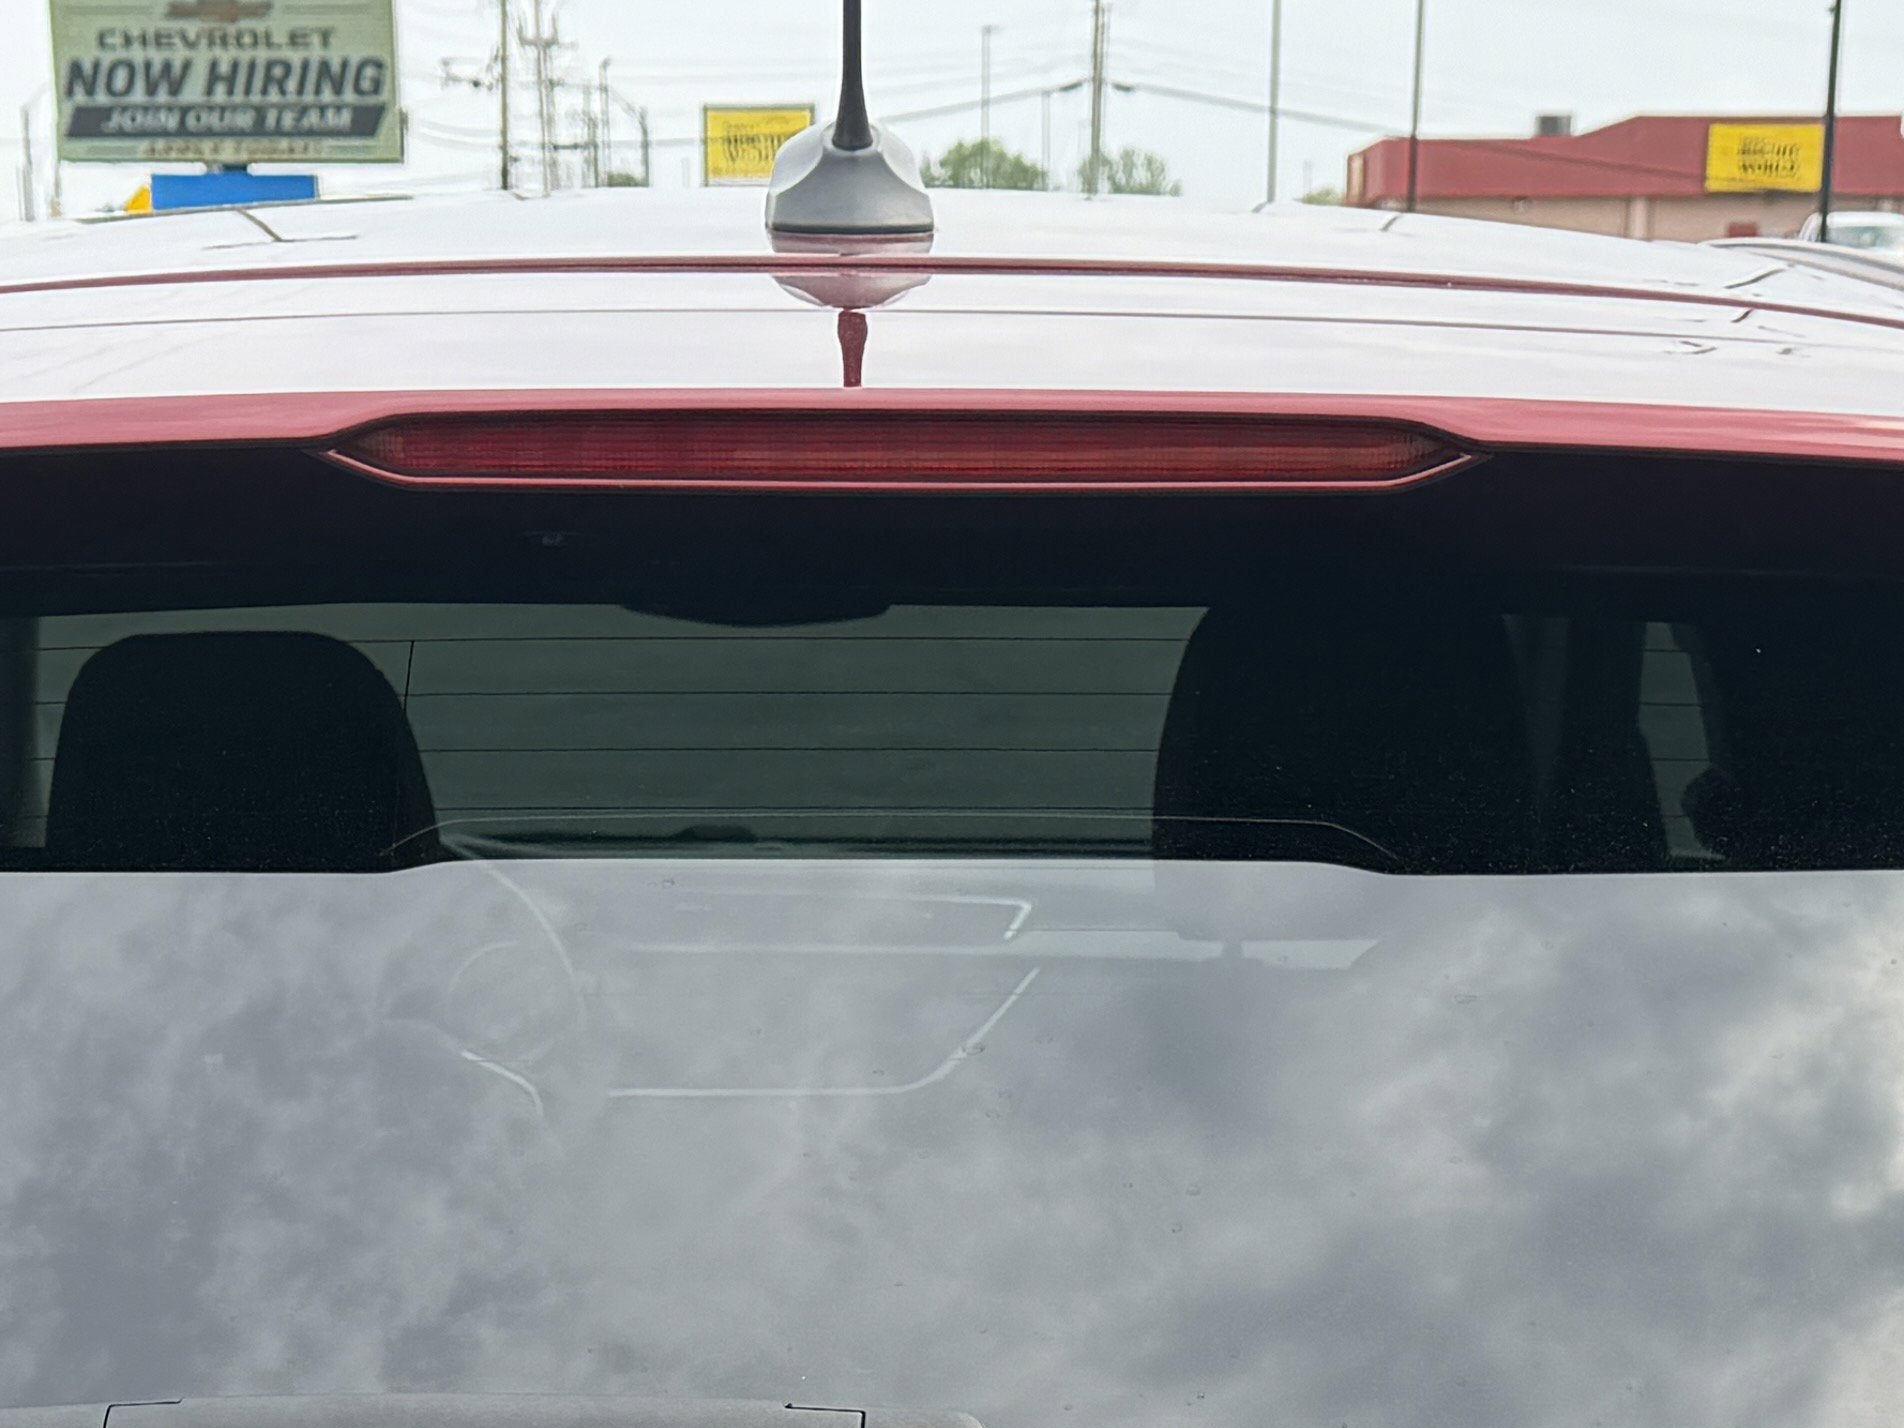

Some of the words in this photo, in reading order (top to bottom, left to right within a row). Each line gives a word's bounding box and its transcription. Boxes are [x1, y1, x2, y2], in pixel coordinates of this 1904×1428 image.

[97, 26, 335, 50] CHEVROLET
[62, 57, 193, 98] NOW
[205, 57, 385, 98] HIRING
[101, 107, 178, 134] JOIN
[184, 108, 256, 134] OUR
[263, 107, 353, 133] TEAM
